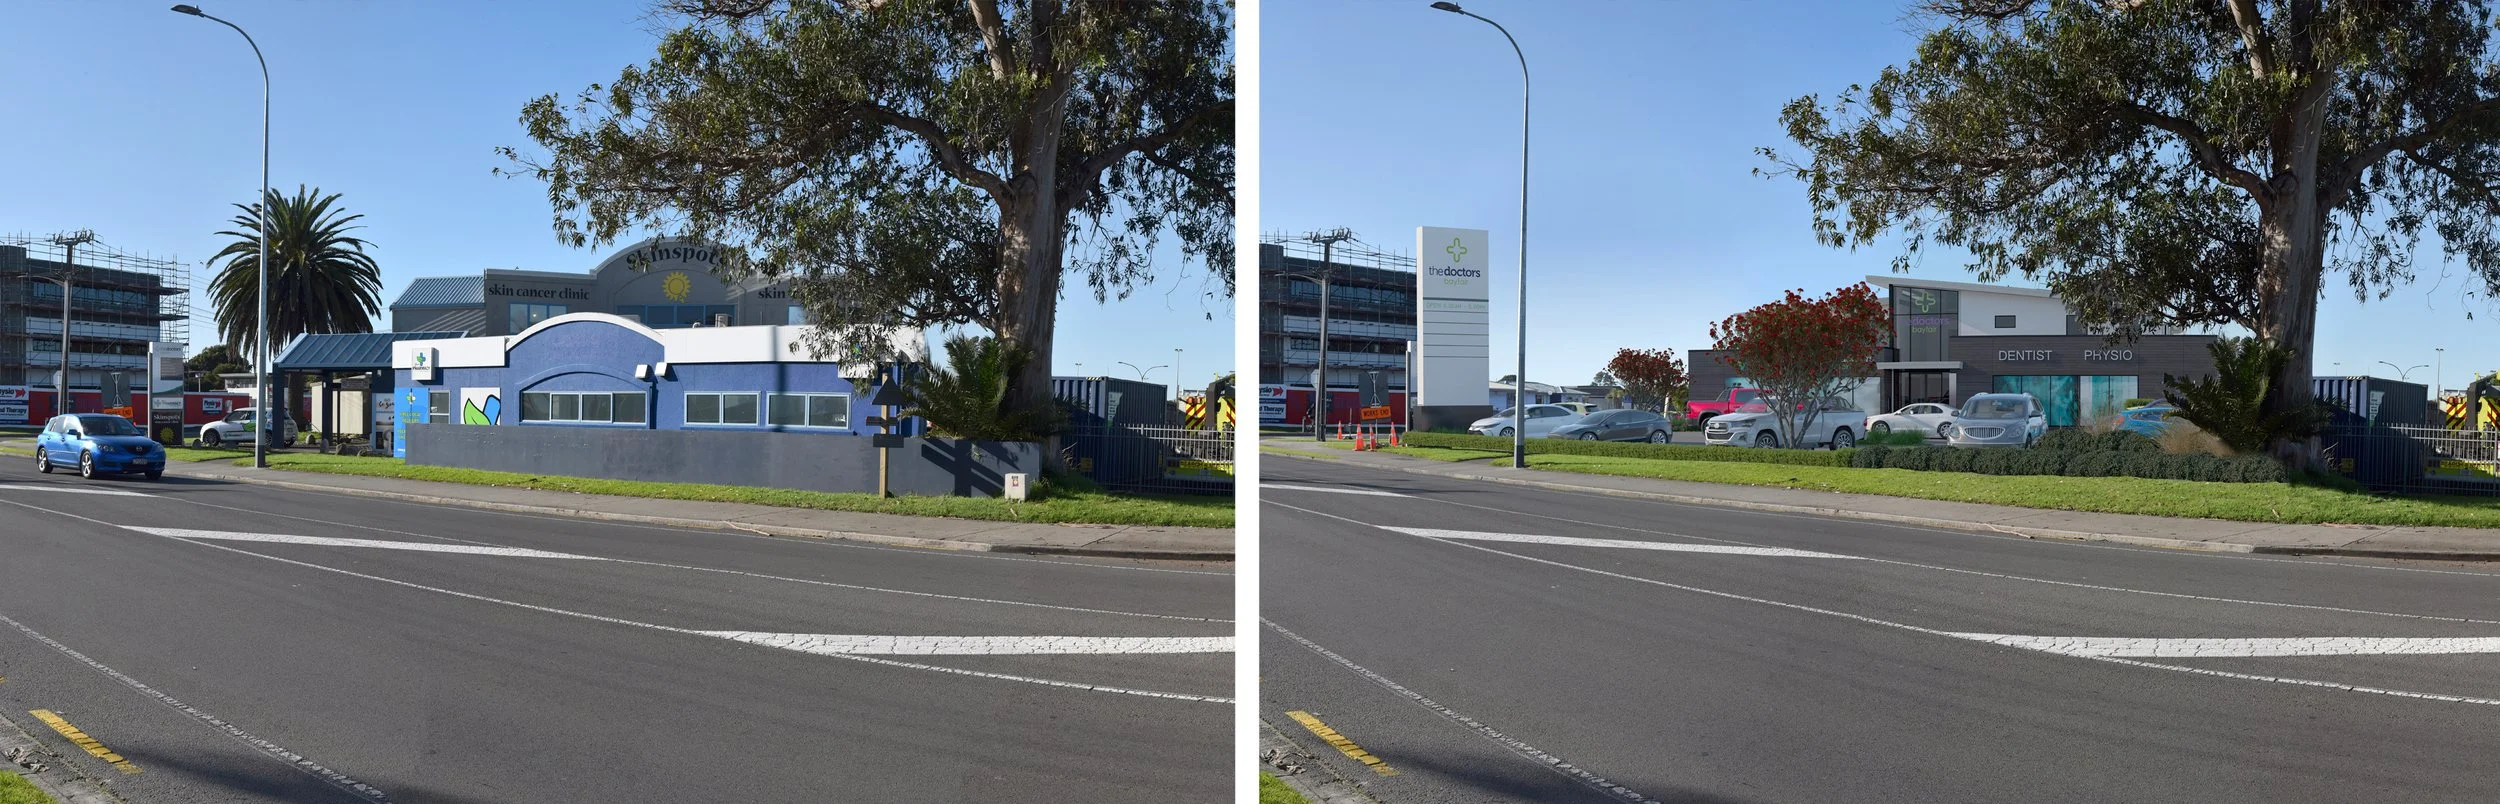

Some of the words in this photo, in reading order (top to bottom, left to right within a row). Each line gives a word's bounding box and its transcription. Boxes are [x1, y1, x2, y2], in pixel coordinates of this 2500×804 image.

[488, 284, 514, 297] skin
[516, 287, 557, 299] cancer
[559, 287, 591, 300] clinic
[758, 287, 786, 299] skin
[1998, 350, 2053, 361] DENTIST
[2084, 349, 2133, 361] PHYSIO
[1264, 405, 1285, 413] Therapy
[1363, 409, 1379, 417] WORKS
[1381, 408, 1389, 416] END
